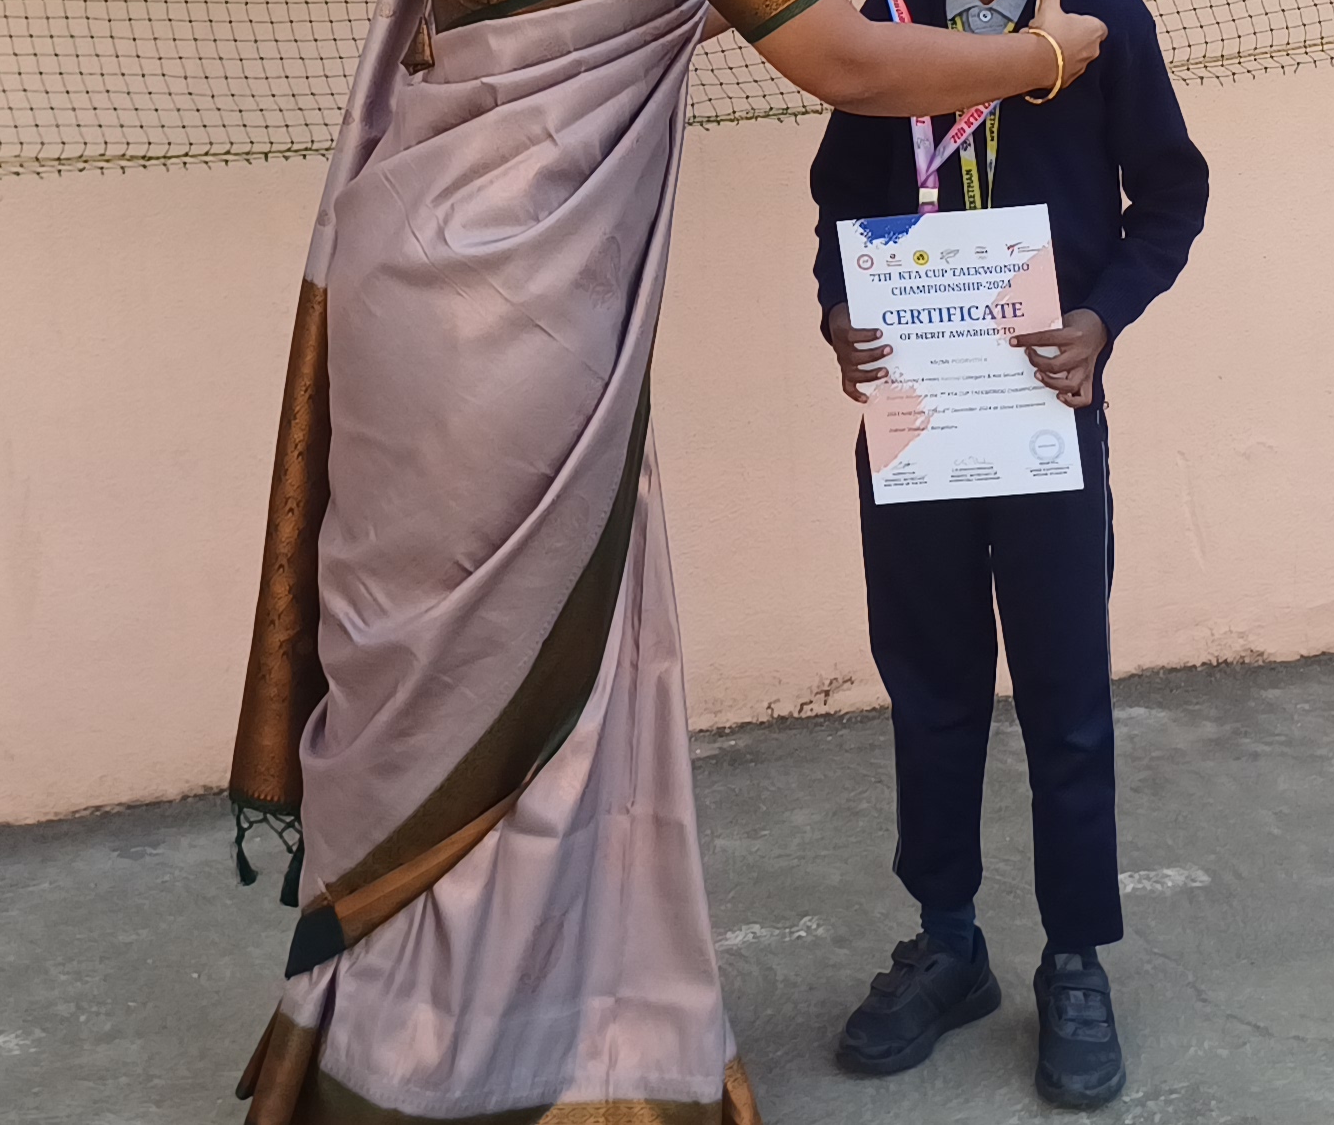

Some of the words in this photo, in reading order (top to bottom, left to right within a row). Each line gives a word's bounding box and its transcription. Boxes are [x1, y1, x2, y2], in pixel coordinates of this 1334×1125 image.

[924, 267, 948, 279] CUP
[949, 262, 1030, 278] TAEKWONDO
[881, 301, 1025, 326] CERTIFICATE
[915, 330, 947, 340] MERIT
[948, 327, 1000, 339] AWARDED
[1001, 326, 1016, 335] TO
